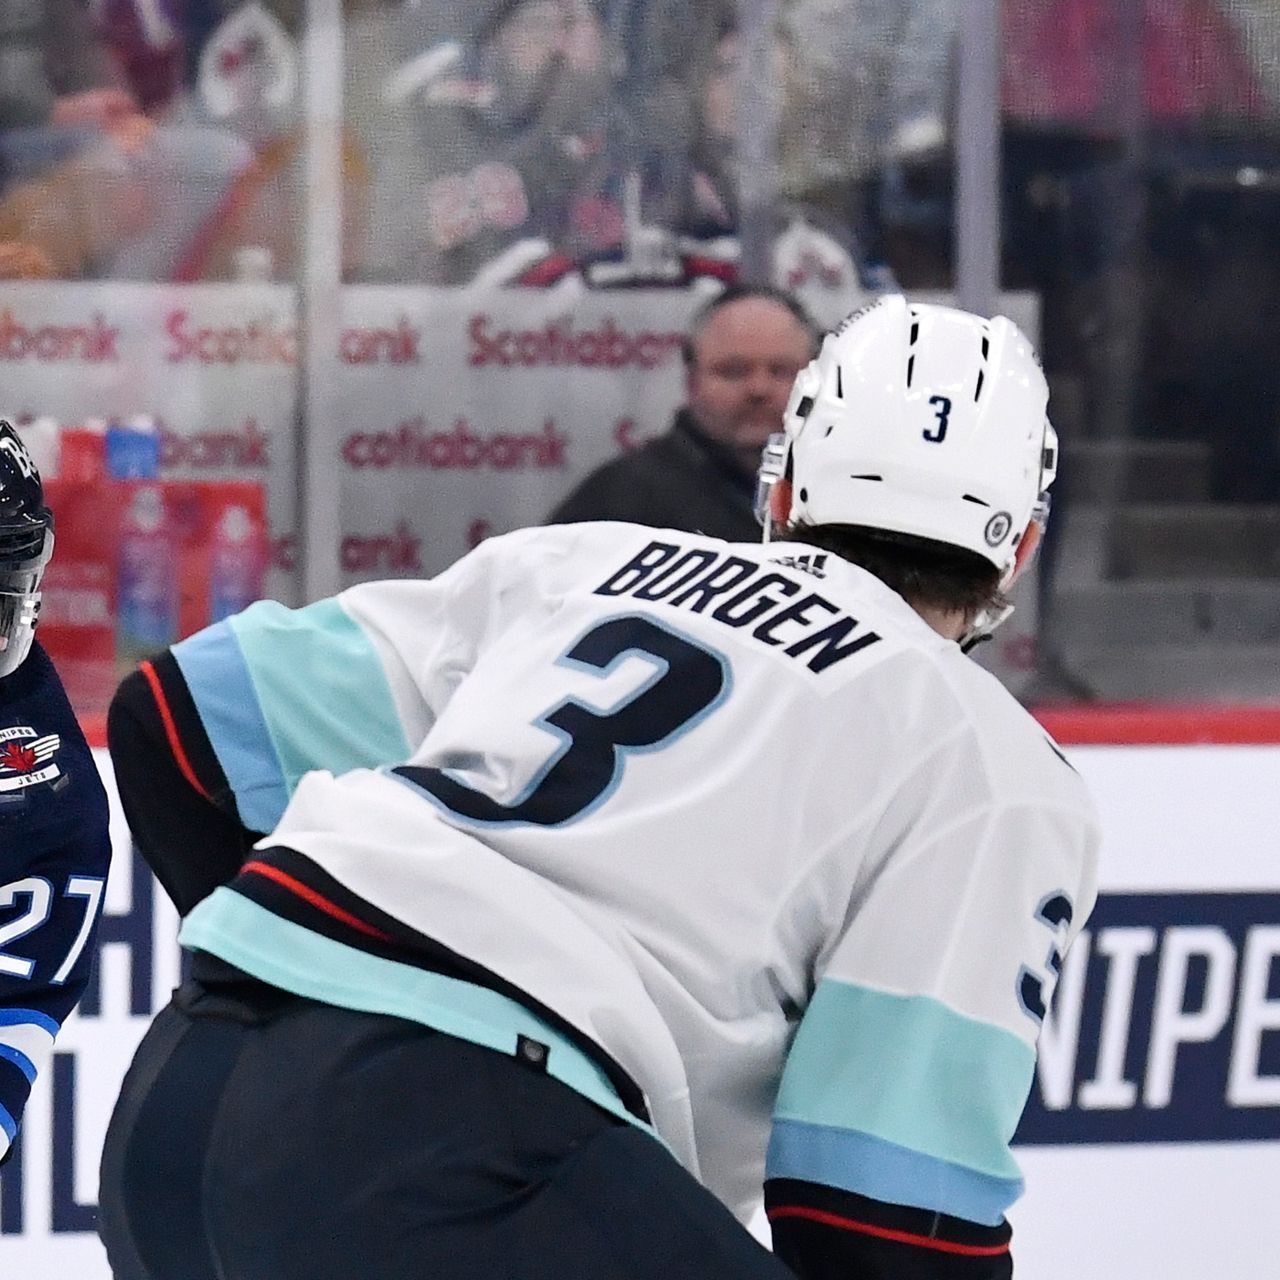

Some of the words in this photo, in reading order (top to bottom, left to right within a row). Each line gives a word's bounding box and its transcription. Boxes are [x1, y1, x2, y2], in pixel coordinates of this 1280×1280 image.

[342, 418, 568, 469] cotiabank
[922, 395, 952, 443] 3
[592, 541, 883, 675] BORGEN
[383, 611, 734, 830] 3
[17, 771, 47, 786] JETS
